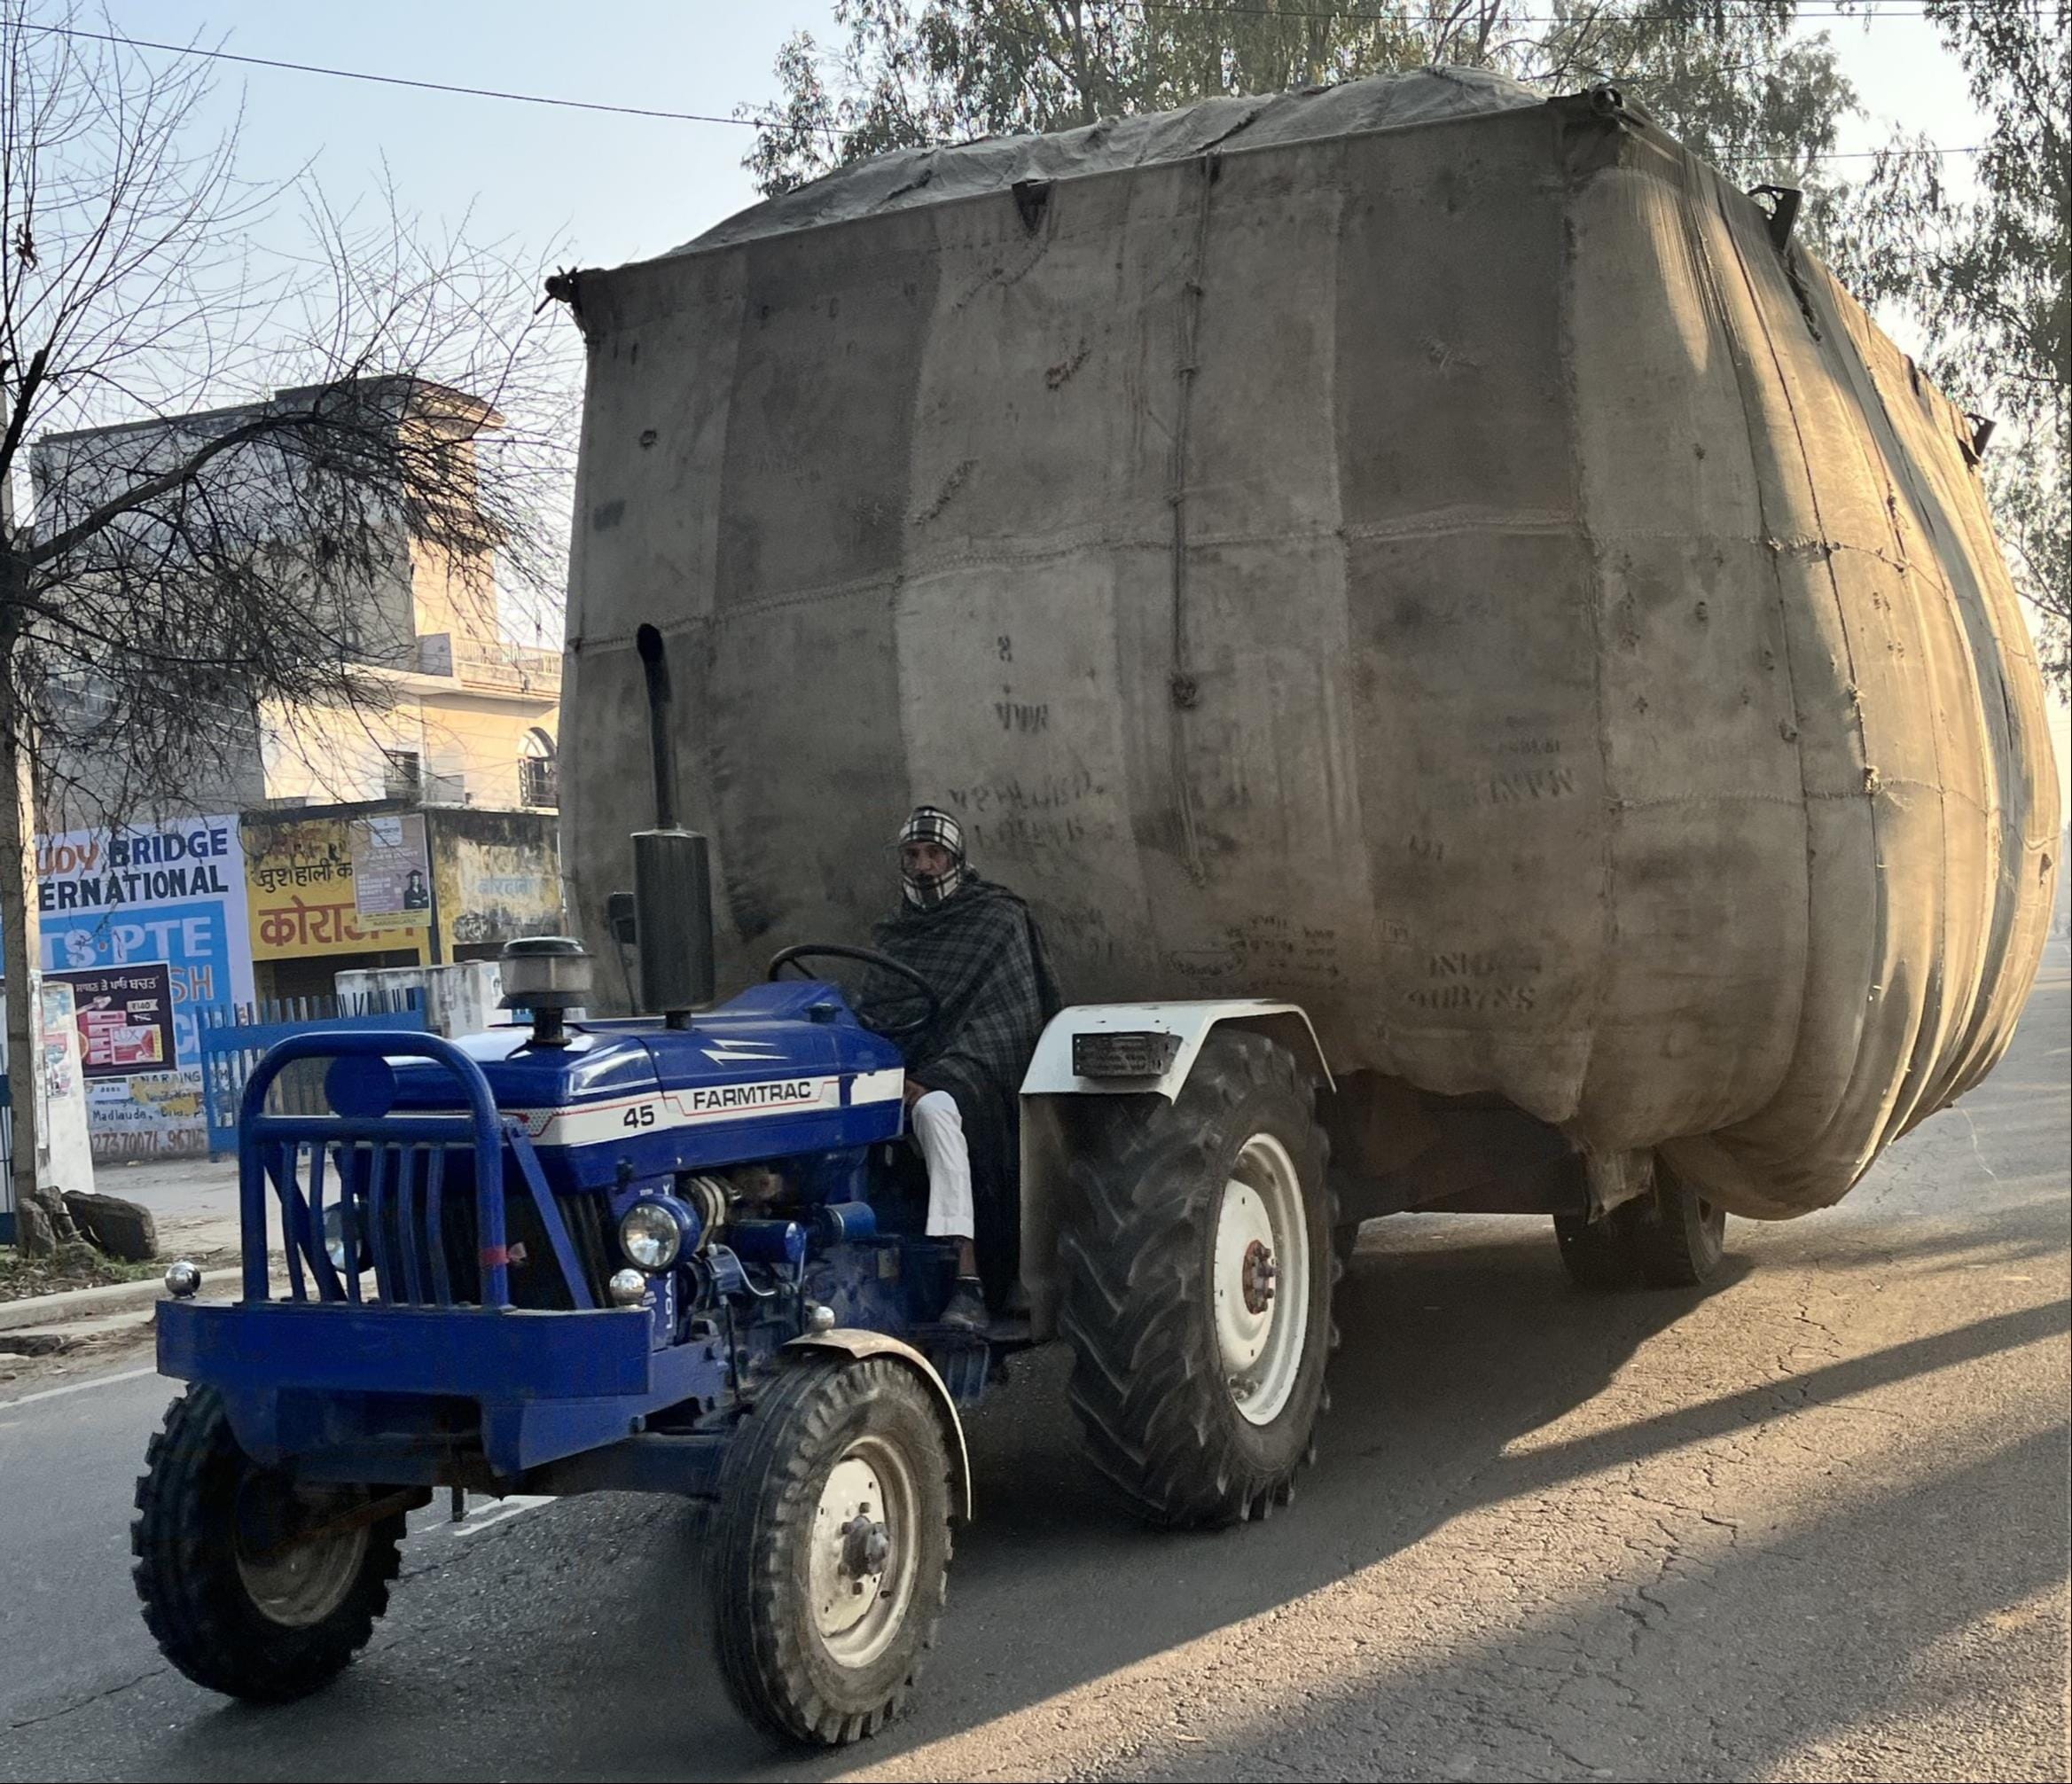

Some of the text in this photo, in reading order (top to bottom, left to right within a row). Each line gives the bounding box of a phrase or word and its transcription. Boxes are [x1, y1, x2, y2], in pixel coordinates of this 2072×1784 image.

[35, 839, 100, 876] UDY
[108, 828, 228, 868] BRIDGE
[38, 865, 229, 912] ERNATIONAL
[623, 1081, 811, 1129] 45 FARMTRAC
